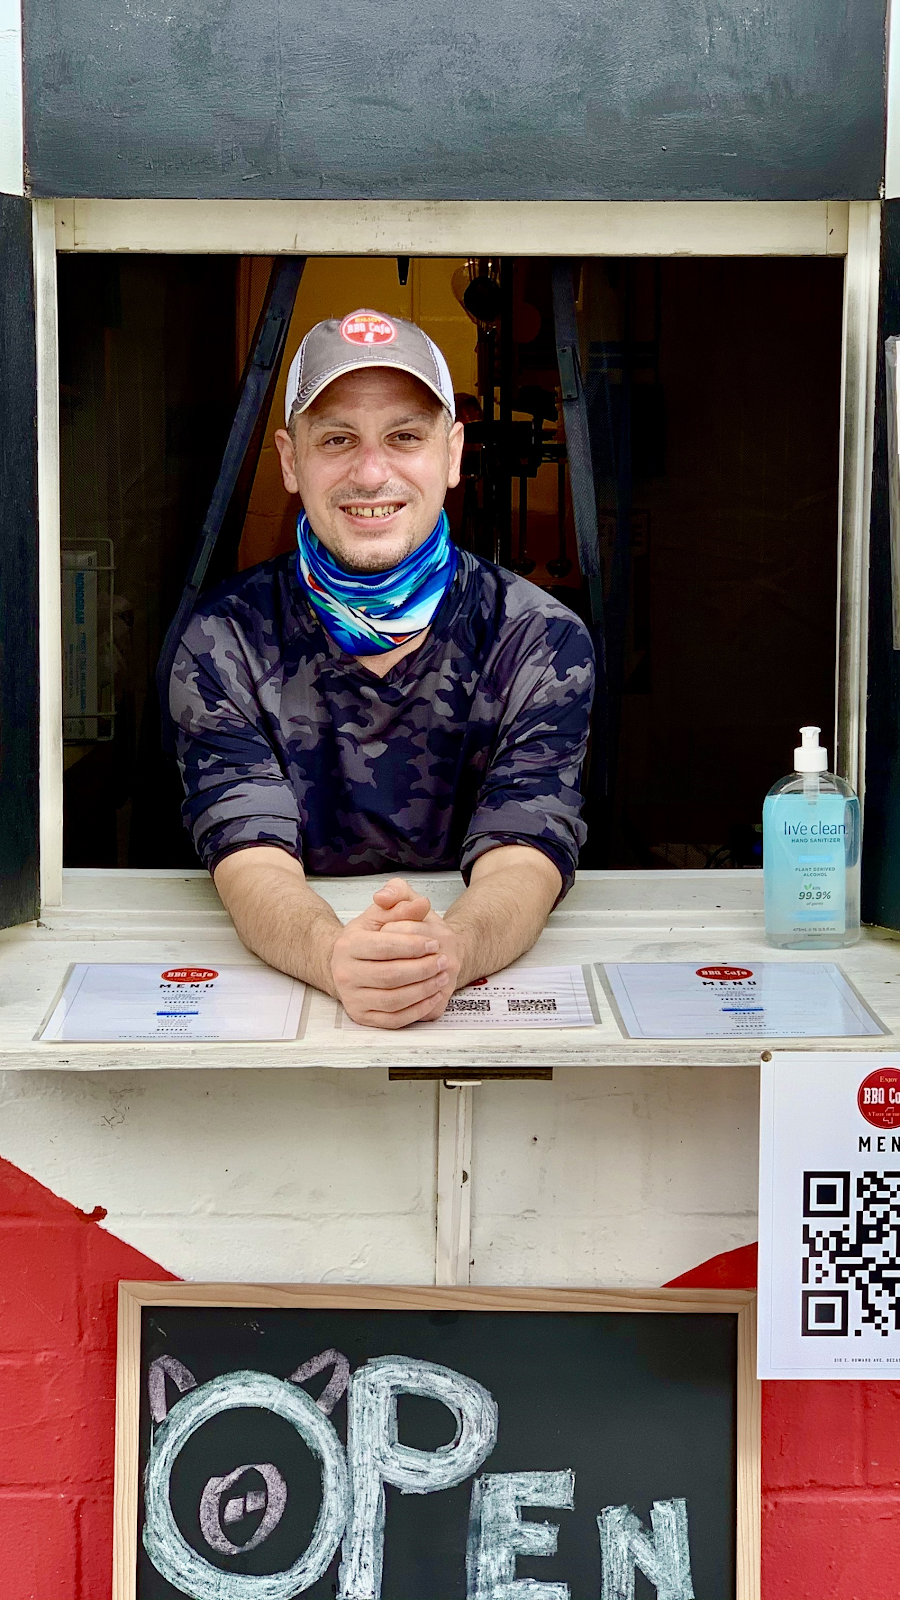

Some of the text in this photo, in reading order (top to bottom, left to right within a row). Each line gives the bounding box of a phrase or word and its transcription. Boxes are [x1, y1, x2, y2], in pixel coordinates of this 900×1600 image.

[347, 322, 391, 335] BBQ Cafe
[784, 820, 808, 836] live
[798, 890, 832, 900] 99.9%
[863, 1087, 886, 1105] BBQ
